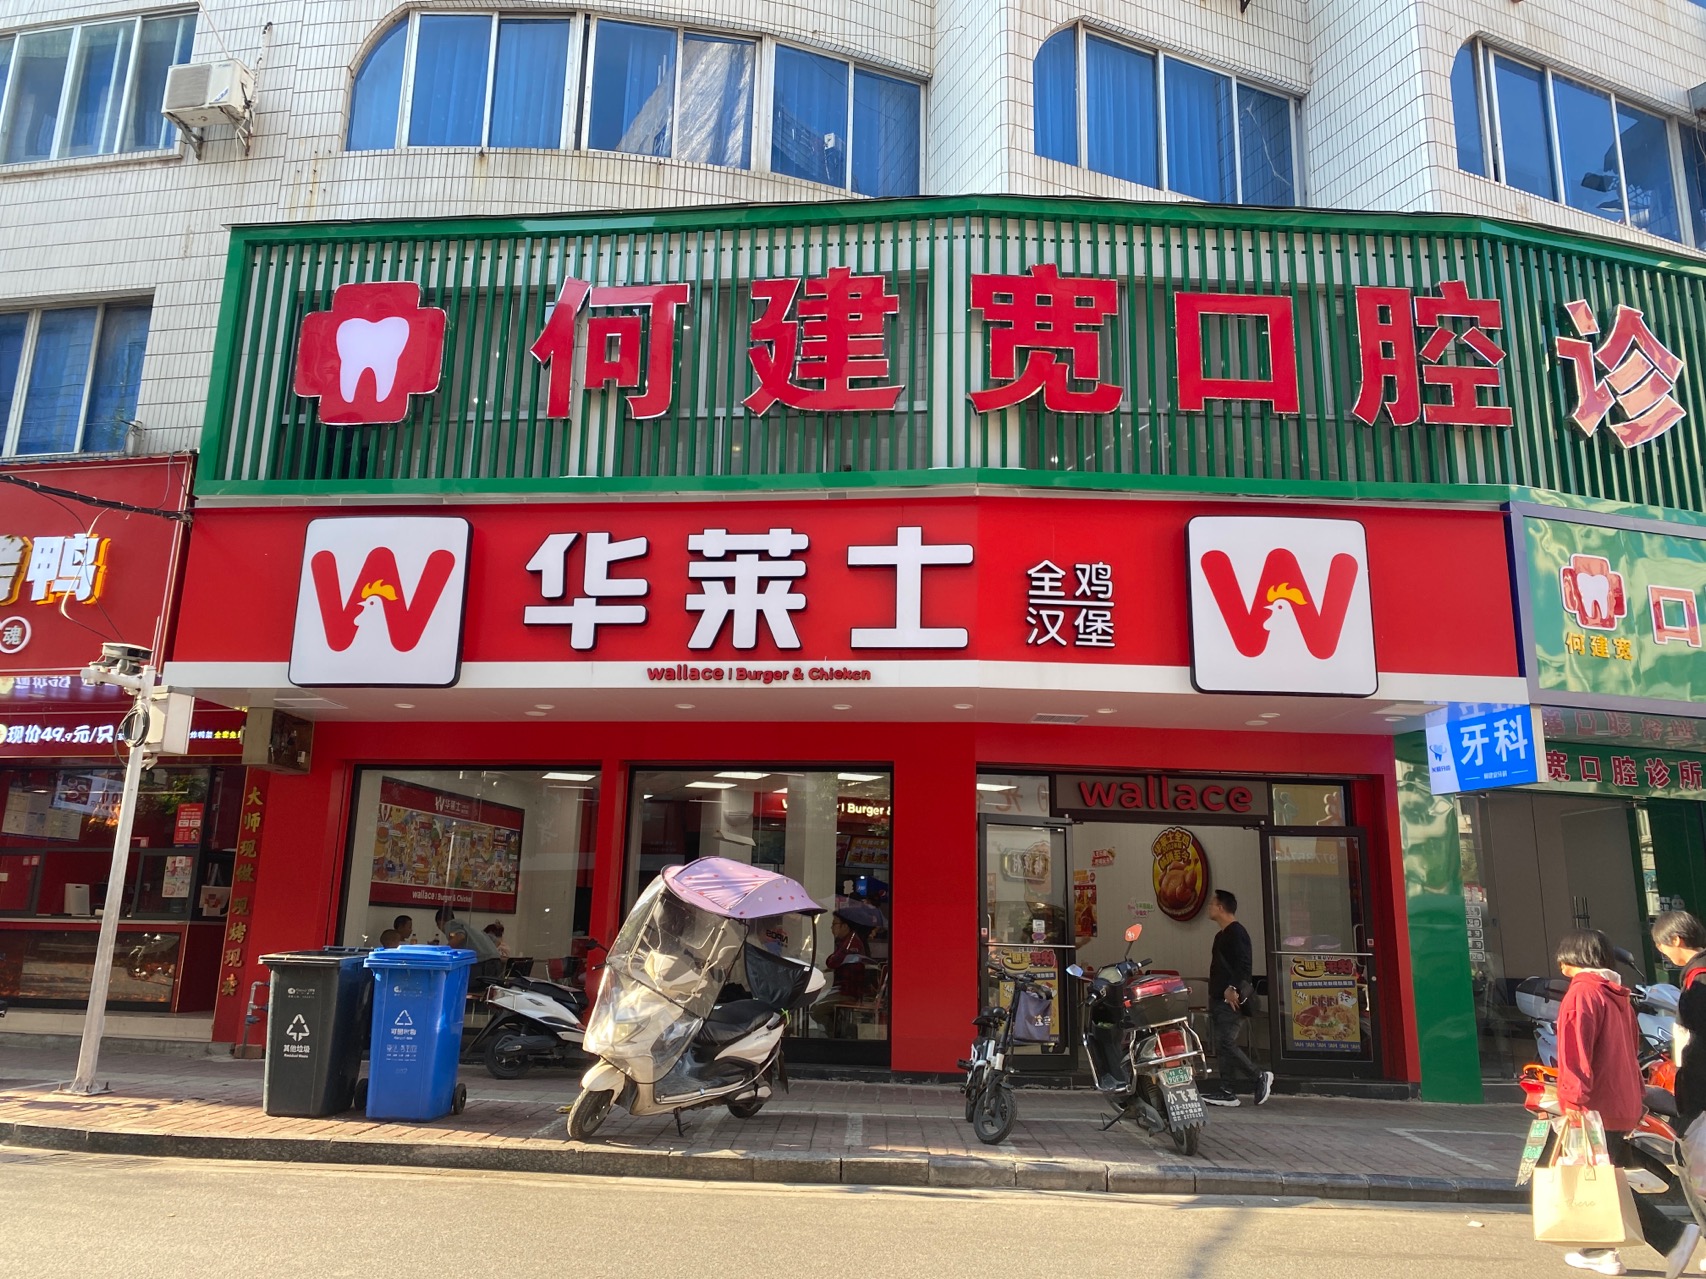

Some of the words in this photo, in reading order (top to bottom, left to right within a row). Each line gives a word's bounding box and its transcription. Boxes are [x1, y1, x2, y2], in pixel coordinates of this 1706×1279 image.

[310, 546, 456, 653] W
[523, 526, 974, 650] 华莱士
[1027, 559, 1114, 600] 全鸡
[1200, 547, 1359, 660] W
[2, 625, 23, 645] 魂
[1026, 607, 1116, 648] 汉堡
[1565, 632, 1634, 662] 何建宽
[647, 664, 724, 681] wallace
[736, 667, 789, 684] Burger
[792, 667, 804, 681] &
[1460, 714, 1529, 766] 牙科
[1545, 749, 1703, 791] 宽口腔诊所
[847, 803, 885, 817] Burger
[1078, 775, 1254, 813] wallace
[412, 890, 435, 901] wallace
